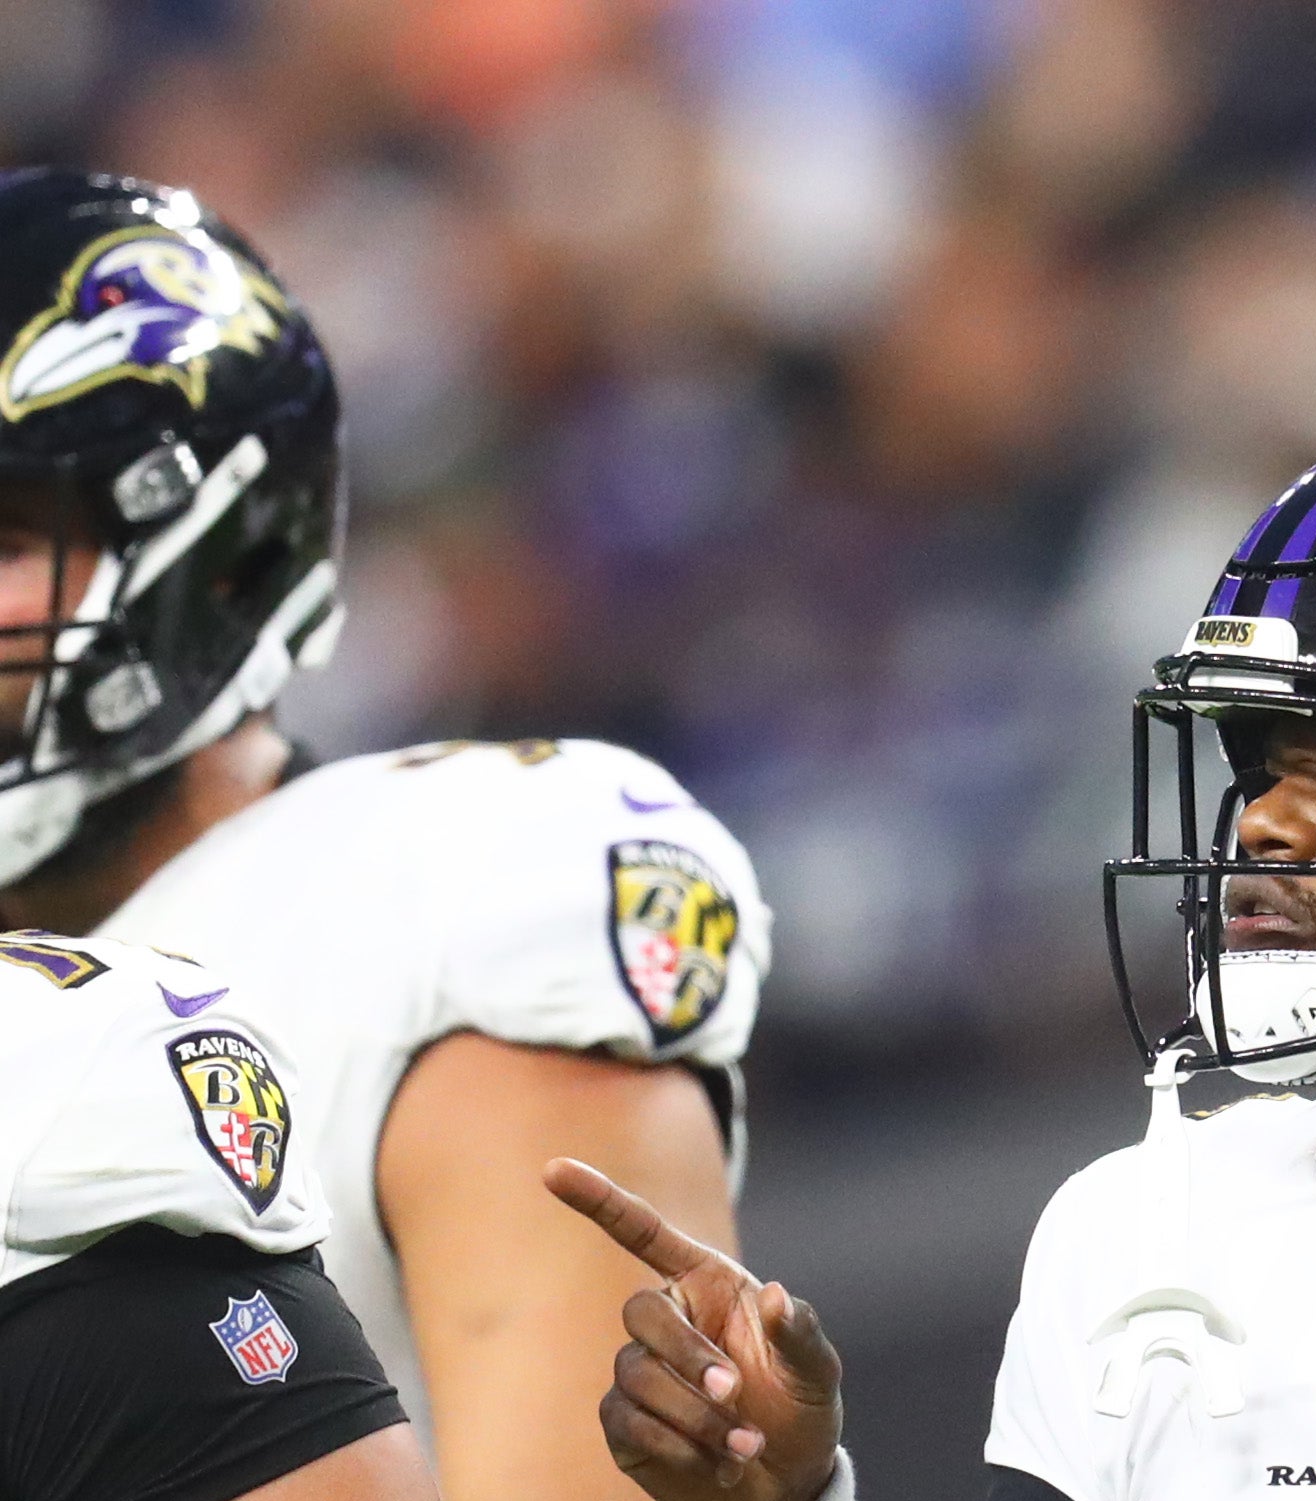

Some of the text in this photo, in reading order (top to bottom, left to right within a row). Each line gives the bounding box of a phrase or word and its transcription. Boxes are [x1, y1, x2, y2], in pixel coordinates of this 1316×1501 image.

[175, 1036, 266, 1070] RAVENS
[188, 1062, 241, 1107] B
[249, 1120, 283, 1173] R
[236, 1326, 292, 1376] NFL
